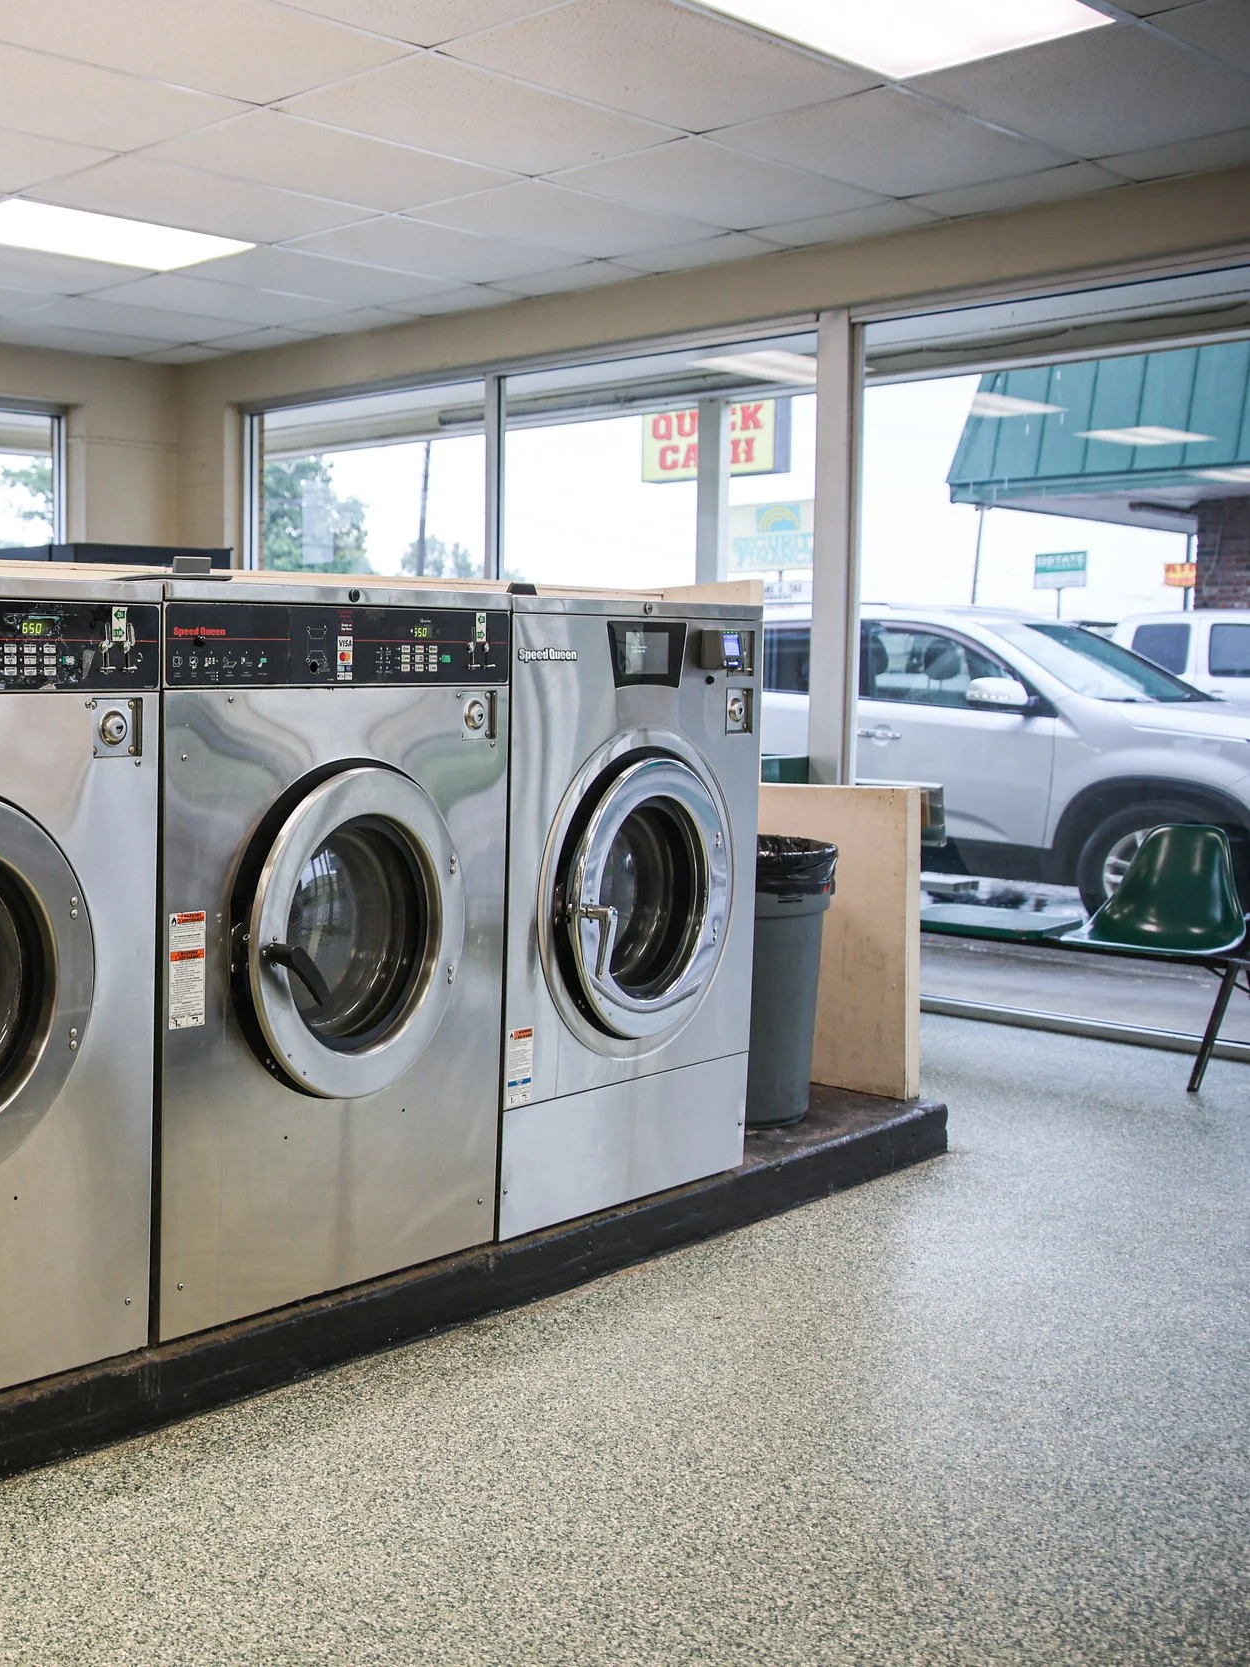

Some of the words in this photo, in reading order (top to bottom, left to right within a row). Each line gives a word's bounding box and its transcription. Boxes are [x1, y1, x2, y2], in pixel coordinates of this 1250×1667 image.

[652, 404, 763, 440] QUK
[659, 437, 755, 470] CAH
[733, 534, 813, 549] SECURIT
[22, 623, 42, 634] 650
[174, 627, 199, 636] Speed
[201, 627, 225, 635] Queen
[518, 648, 549, 662] Speed
[549, 649, 577, 660] Queen
